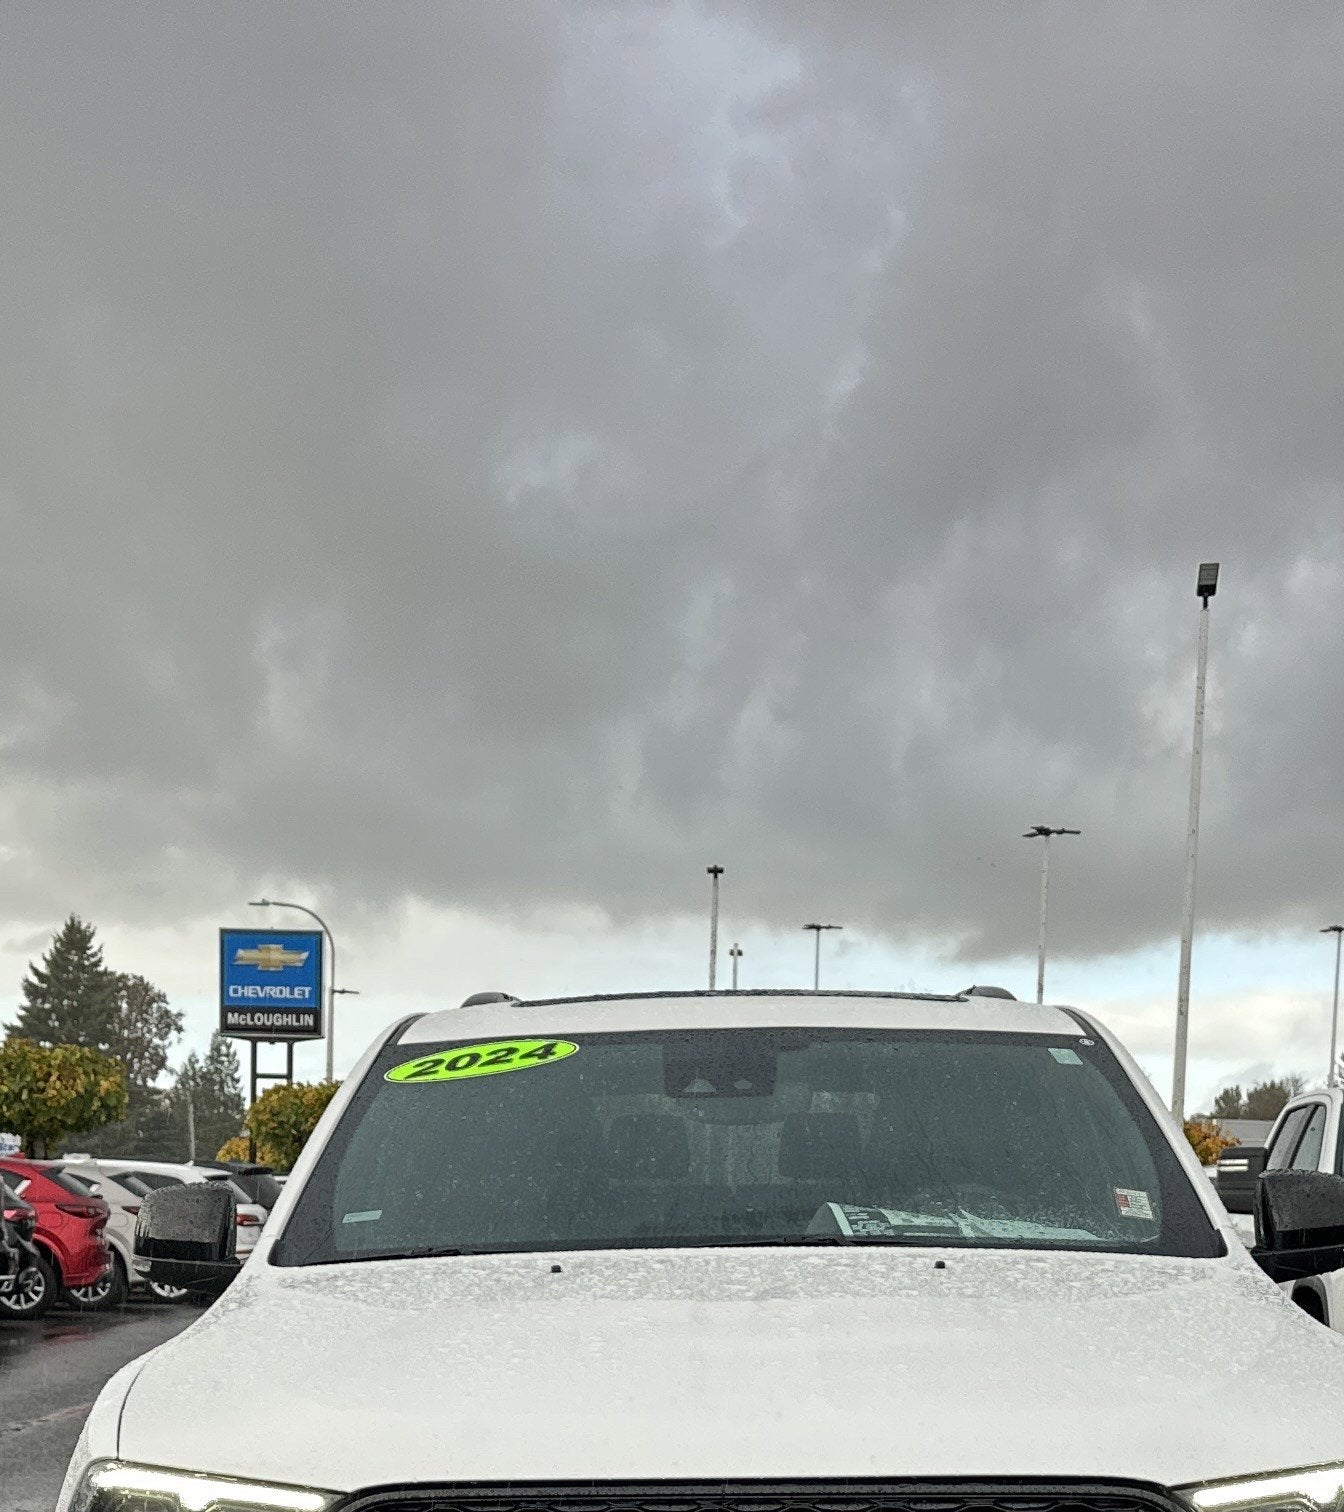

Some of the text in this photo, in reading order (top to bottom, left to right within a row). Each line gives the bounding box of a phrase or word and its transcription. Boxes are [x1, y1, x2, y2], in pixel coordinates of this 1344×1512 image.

[228, 985, 312, 999] CHEVROLET
[226, 1011, 314, 1026] McLOUGHLIN
[403, 1042, 560, 1081] 2024
